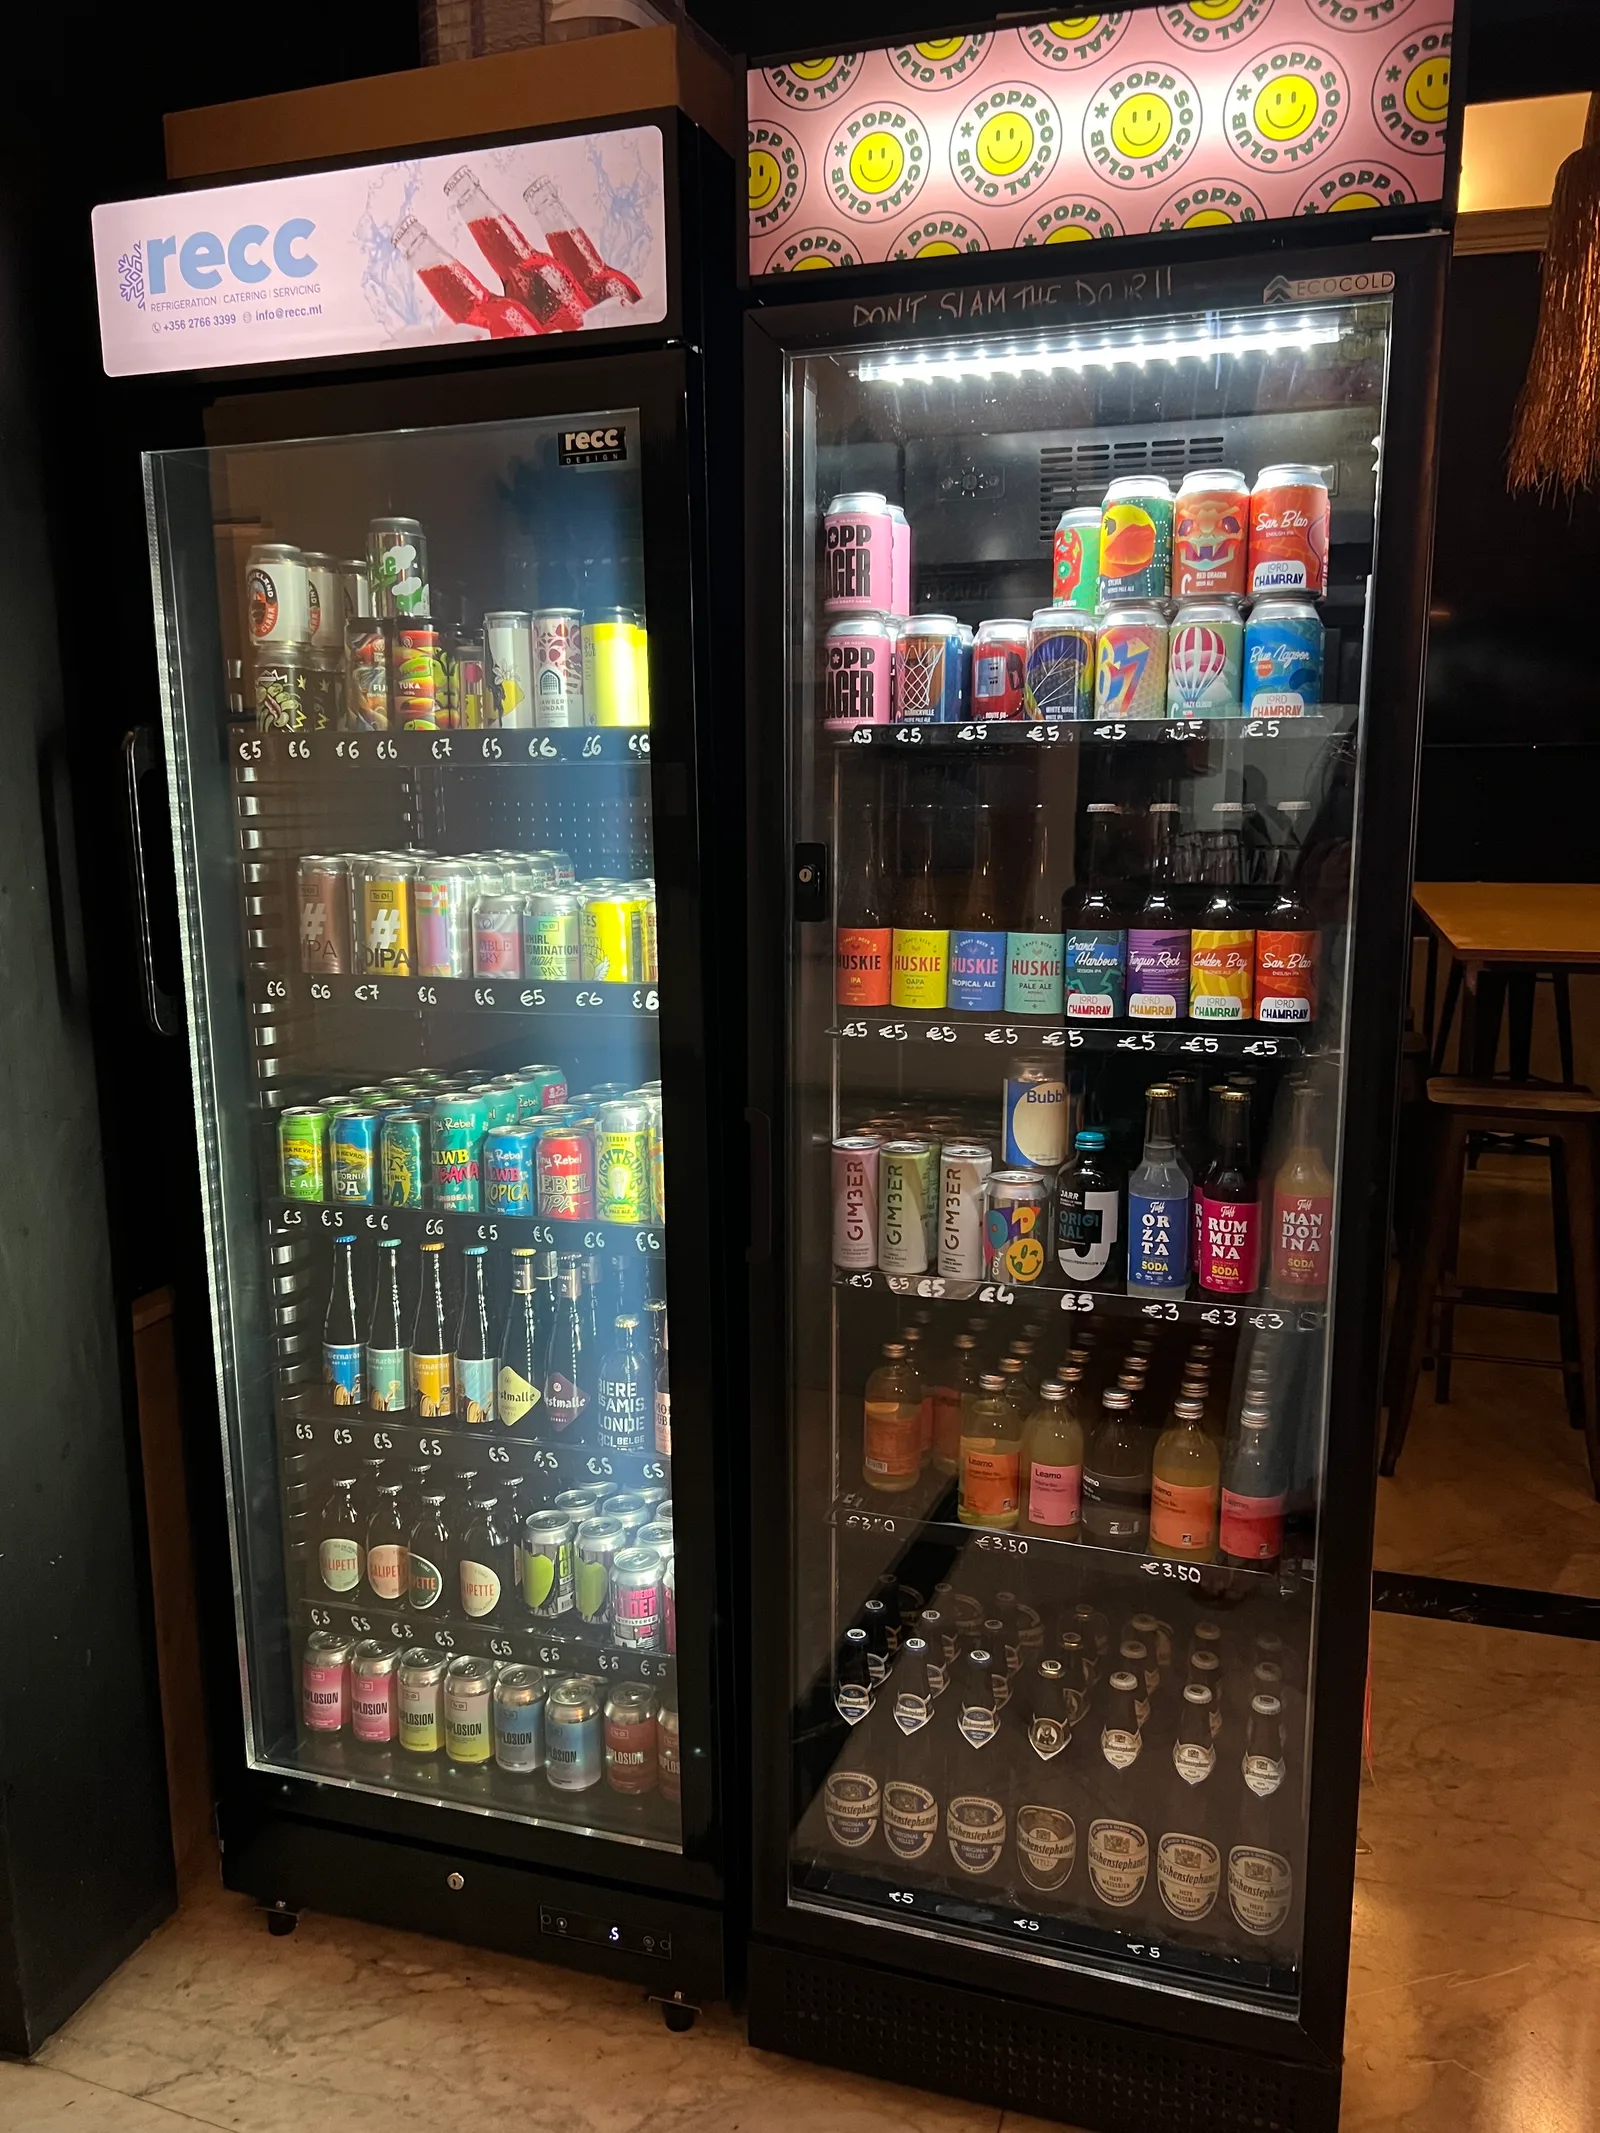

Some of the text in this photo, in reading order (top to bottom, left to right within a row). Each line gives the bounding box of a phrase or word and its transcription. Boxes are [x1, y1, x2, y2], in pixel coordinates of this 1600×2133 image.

[1232, 52, 1341, 164] POPP SOCIAL CLUB
[1091, 71, 1194, 181] POPP SOCIAL CLUB
[1381, 94, 1429, 146] CLUB
[957, 90, 1054, 198] POPP SOCIAL CLUB
[831, 111, 923, 215] POPP SOCIAL CLUB
[756, 147, 799, 228] SOCIAL
[1319, 169, 1391, 199] POPP
[1174, 187, 1242, 215] POPP
[1037, 204, 1101, 231] POPP
[907, 220, 968, 247] POPP
[146, 218, 319, 296] recc
[785, 236, 841, 261] POPP
[1296, 272, 1393, 297] ECOCOLD
[150, 284, 321, 312] REFRIGERATION CATERING SERVICING
[163, 304, 323, 331] +356 2766 3399 info@recc.mt
[853, 294, 927, 328] DON'T
[565, 428, 619, 451] recc
[825, 525, 872, 549] OPP
[825, 548, 871, 599] AGER
[1268, 563, 1288, 573] LORD
[1254, 573, 1304, 588] CHAMBRAY
[825, 647, 875, 670] OPP
[1250, 646, 1271, 664] Blue
[826, 670, 874, 718] AGER
[1267, 694, 1287, 704] LORD
[957, 724, 988, 741] €5
[1026, 725, 1060, 742] €5
[1093, 724, 1127, 740] €5
[239, 740, 262, 760] €5
[288, 739, 310, 759] €6
[376, 739, 398, 759] €6
[431, 738, 452, 760] €7
[482, 737, 502, 759] €5
[528, 737, 557, 758] €6
[894, 956, 941, 972] HUSKIE
[951, 957, 998, 974] HUSKIE
[1011, 960, 1061, 976] HUSKIE
[1225, 952, 1248, 972] Bay
[267, 981, 286, 997] €6
[311, 984, 331, 999] €6
[951, 979, 981, 987] TROPICAL
[354, 984, 380, 1001] €7
[417, 986, 437, 1005] €6
[474, 988, 495, 1006] €6
[520, 989, 546, 1007] €5
[576, 992, 603, 1007] €6
[1079, 995, 1098, 1004] LORD
[1141, 995, 1160, 1005] LORD
[1206, 996, 1226, 1006] LORD
[1068, 1004, 1113, 1016] CHAMBRAY
[1130, 1004, 1174, 1016] CHAMBRAY
[1274, 998, 1295, 1008] LORD
[1194, 1006, 1240, 1018] CHAMBRAY
[1262, 1008, 1308, 1020] CHAMBRAY
[444, 1113, 476, 1131] Rebel
[495, 1148, 524, 1161] Rebel
[553, 1153, 582, 1170] Rebel
[541, 1173, 590, 1194] EBEL
[1060, 1189, 1079, 1200] JARR
[443, 1202, 457, 1210] IPA
[283, 1209, 301, 1224] €5
[321, 1209, 343, 1227] €5
[365, 1214, 389, 1231] €6
[1059, 1210, 1099, 1227] ORIGI
[1141, 1213, 1170, 1228] OR
[1282, 1210, 1324, 1226] MAN
[425, 1218, 444, 1235] €6
[477, 1224, 498, 1241] €5
[1059, 1223, 1084, 1239] NAL
[1208, 1217, 1248, 1234] RUM
[1282, 1224, 1322, 1240] DOL
[532, 1225, 554, 1244] €6
[584, 1231, 605, 1249] €6
[635, 1231, 660, 1252] €6
[1209, 1233, 1245, 1247] MIE
[1141, 1241, 1169, 1256] TA
[1211, 1245, 1241, 1260] NA
[1281, 1237, 1321, 1252] INA
[991, 1251, 1004, 1276] COLA
[1141, 1260, 1169, 1271] SODA
[1211, 1265, 1239, 1277] SODA
[1287, 1257, 1315, 1269] SODA
[917, 1279, 946, 1297] €5
[979, 1284, 1014, 1305] €4
[1142, 1303, 1180, 1321] €3
[1201, 1309, 1237, 1326] €3
[1249, 1313, 1283, 1330] €3
[500, 1391, 535, 1403] stmalle
[295, 1423, 314, 1440] €5
[333, 1429, 353, 1445] €5
[617, 1434, 645, 1445] BELGE
[373, 1432, 393, 1449] €5
[419, 1438, 442, 1456] €5
[488, 1446, 510, 1463] €5
[968, 1455, 993, 1468] Leamo
[643, 1462, 664, 1479] €5
[1035, 1468, 1062, 1479] Leamo
[975, 1535, 1028, 1555] €3.50
[1140, 1562, 1201, 1583] €3.50
[310, 1608, 331, 1626] €5
[350, 1615, 371, 1632] €5
[390, 1622, 414, 1639] €5
[434, 1630, 455, 1648] €5
[304, 1691, 339, 1705] PLOSION
[353, 1702, 388, 1716] PLOSION
[501, 1732, 532, 1745] LOSION
